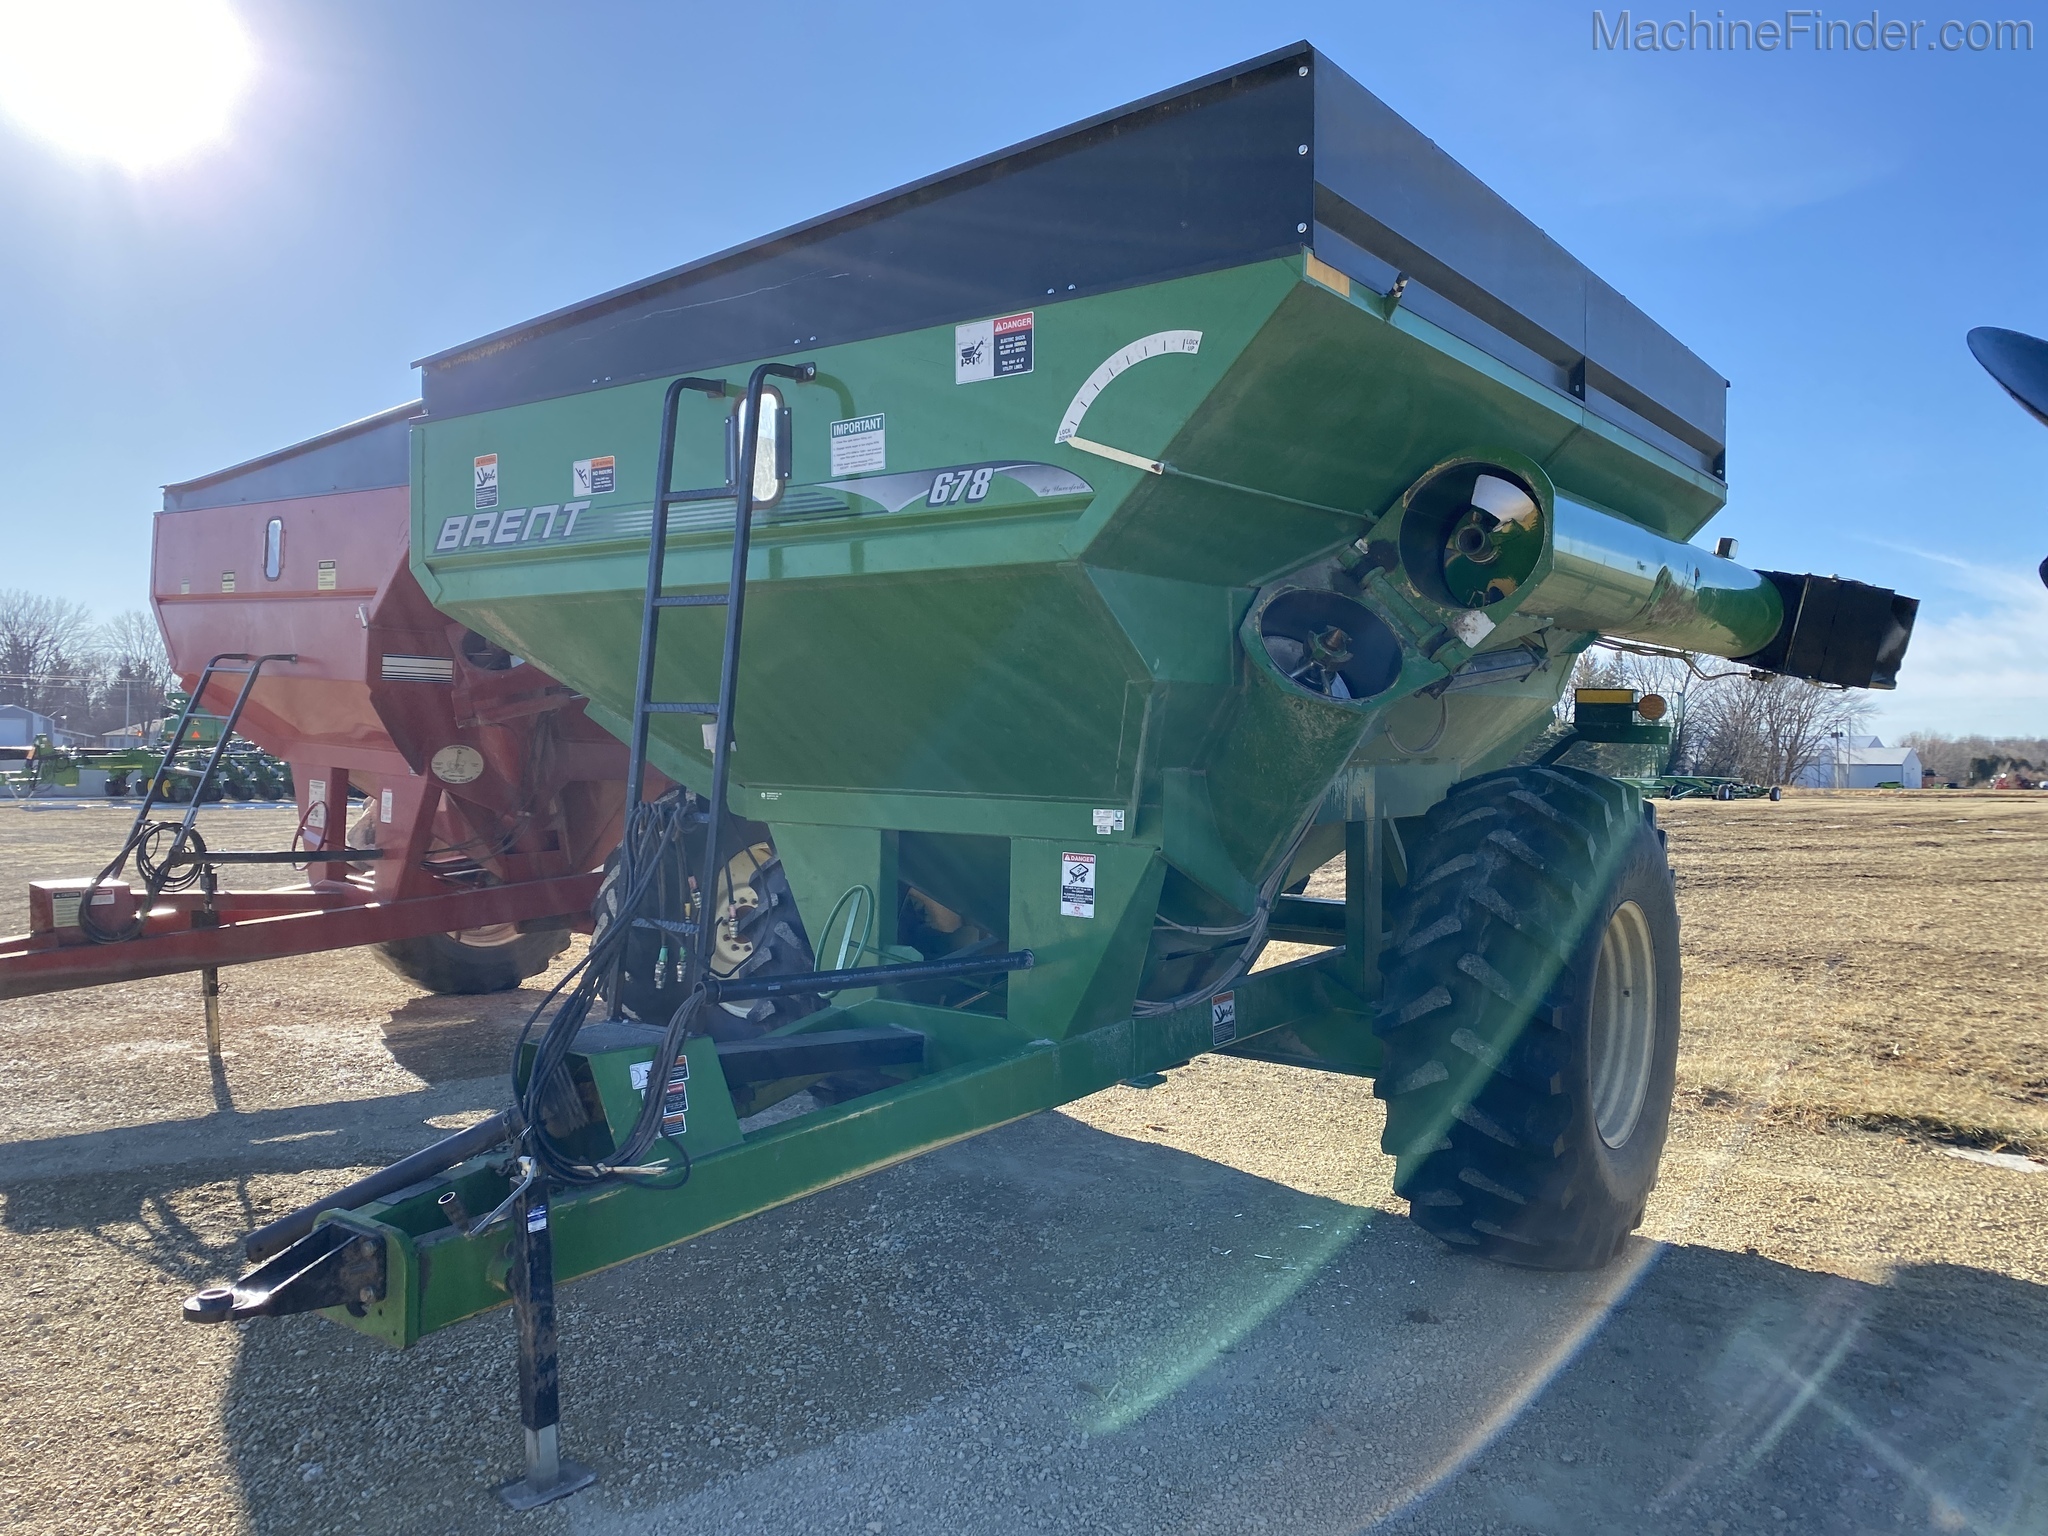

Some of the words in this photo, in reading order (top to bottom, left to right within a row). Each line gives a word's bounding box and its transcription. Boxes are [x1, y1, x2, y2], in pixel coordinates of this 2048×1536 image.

[1002, 318, 1032, 330] DANGER
[833, 417, 881, 436] IMPORTANT
[928, 467, 995, 504] 678
[436, 500, 592, 550] BRENT
